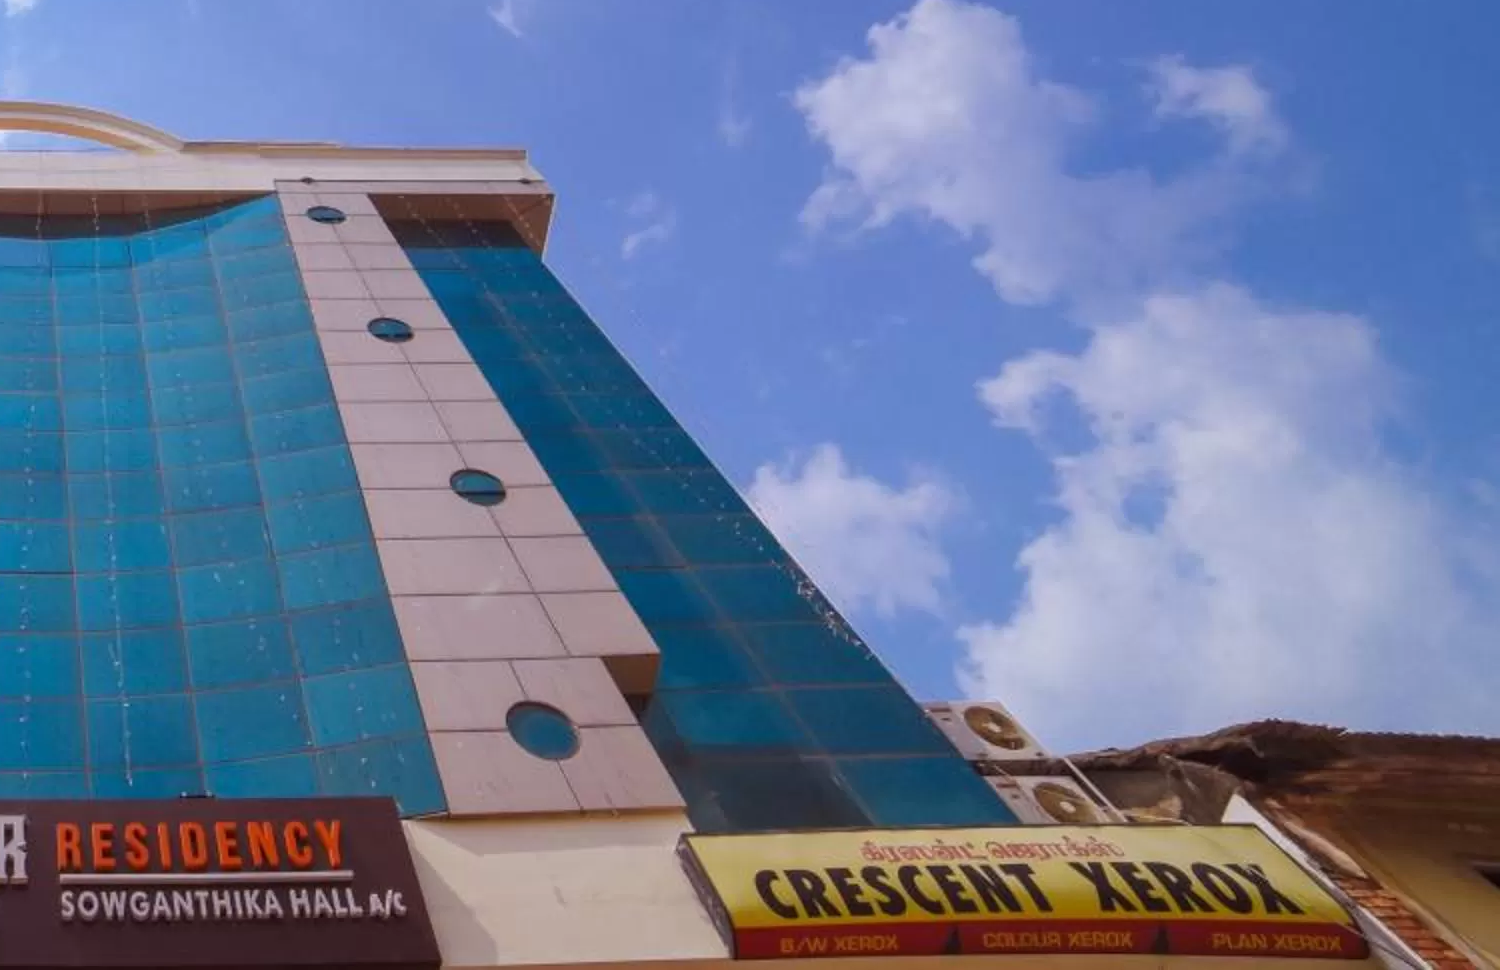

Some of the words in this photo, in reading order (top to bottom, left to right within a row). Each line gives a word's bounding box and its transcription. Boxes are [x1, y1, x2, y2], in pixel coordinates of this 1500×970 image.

[56, 820, 342, 870] RESIDENCY
[754, 861, 1054, 919] CRESCENT
[1067, 861, 1306, 916] XEROX
[60, 889, 284, 921] SOWGANTHIKA
[289, 887, 363, 918] HALL
[833, 934, 899, 951] XEROX
[983, 932, 1061, 949] COLOUR
[1067, 932, 1133, 949] XEROX
[1212, 934, 1268, 950] PLAN
[1273, 934, 1342, 952] XEROX
